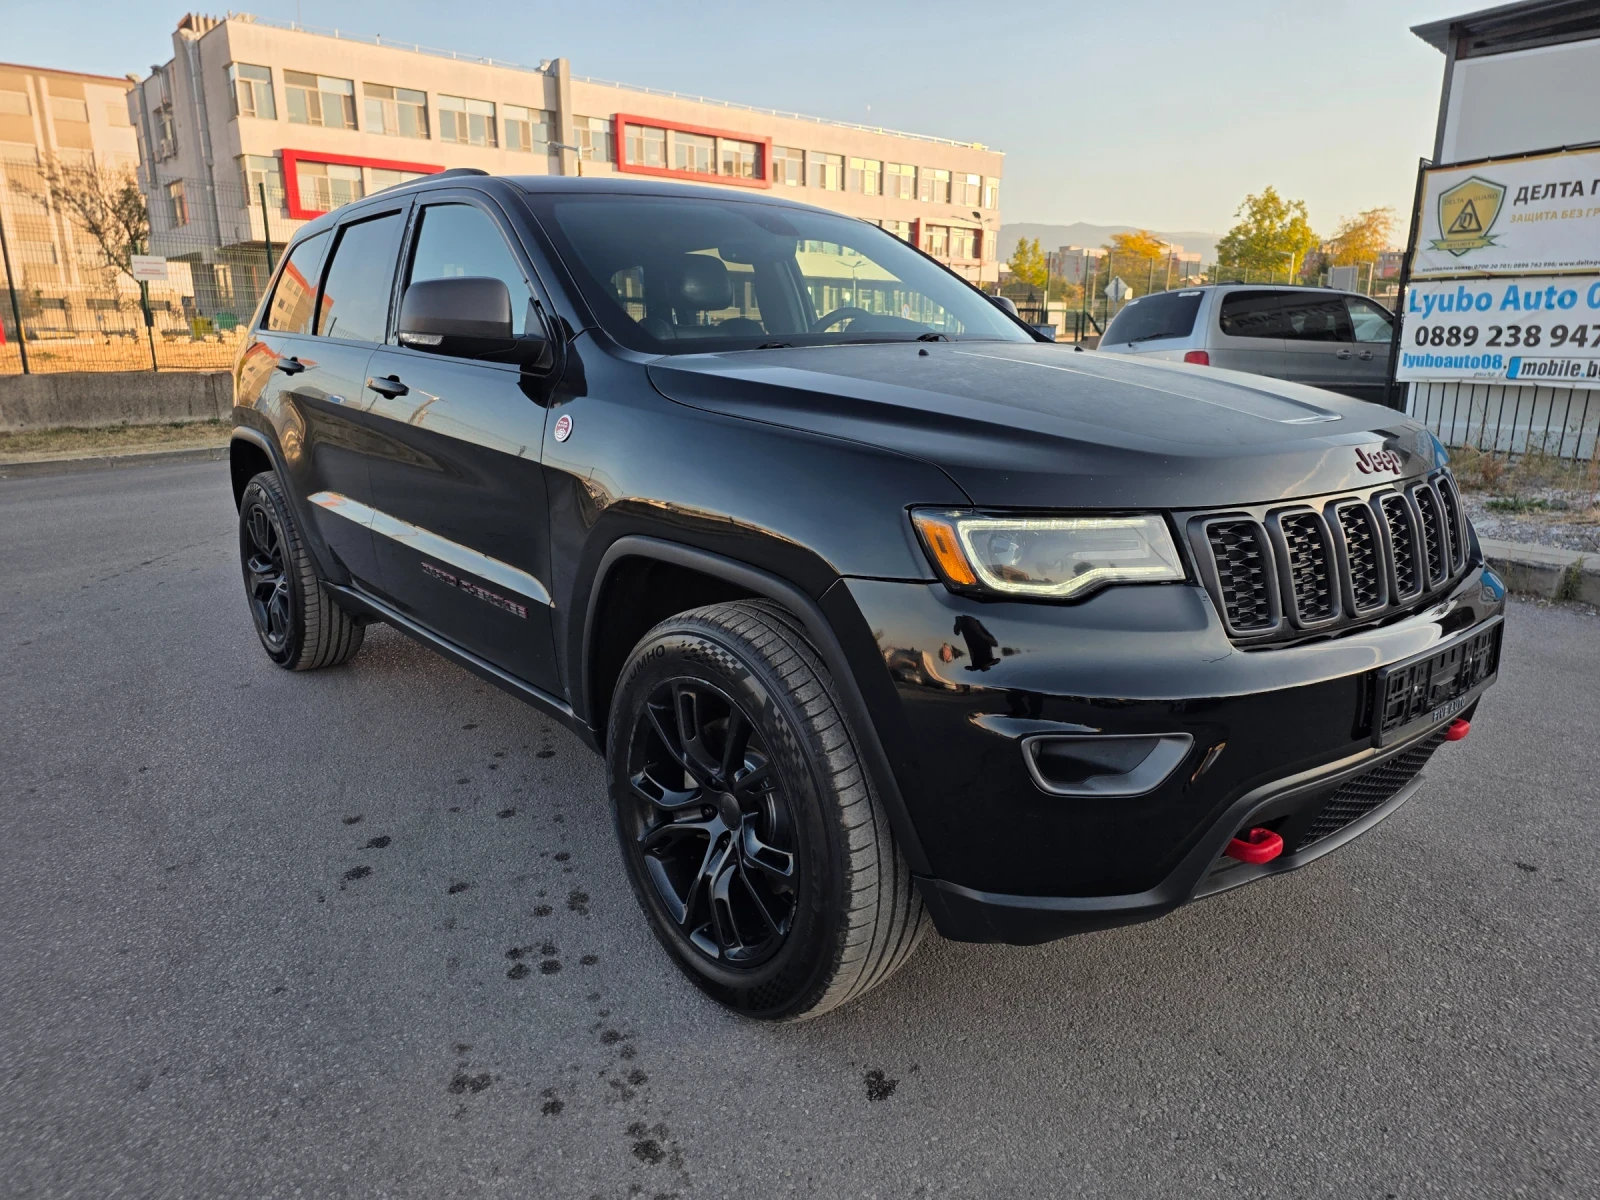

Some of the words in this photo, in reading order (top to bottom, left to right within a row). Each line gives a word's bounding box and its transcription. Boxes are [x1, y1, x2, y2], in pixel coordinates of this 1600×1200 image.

[1444, 197, 1465, 206] DELTA
[1473, 193, 1498, 203] GUARD
[1513, 180, 1584, 207] ДЕЛТА
[1510, 210, 1558, 224] ЗАЩИТА
[1561, 208, 1583, 219] БЕЗ
[1409, 285, 1493, 320] Lyubo
[1498, 283, 1578, 312] Auto
[1414, 325, 1480, 348] 0889
[1485, 324, 1542, 348] 238
[1354, 447, 1403, 475] Jeep
[1432, 705, 1449, 723] FIVE
[1449, 695, 1466, 714] AUTO
